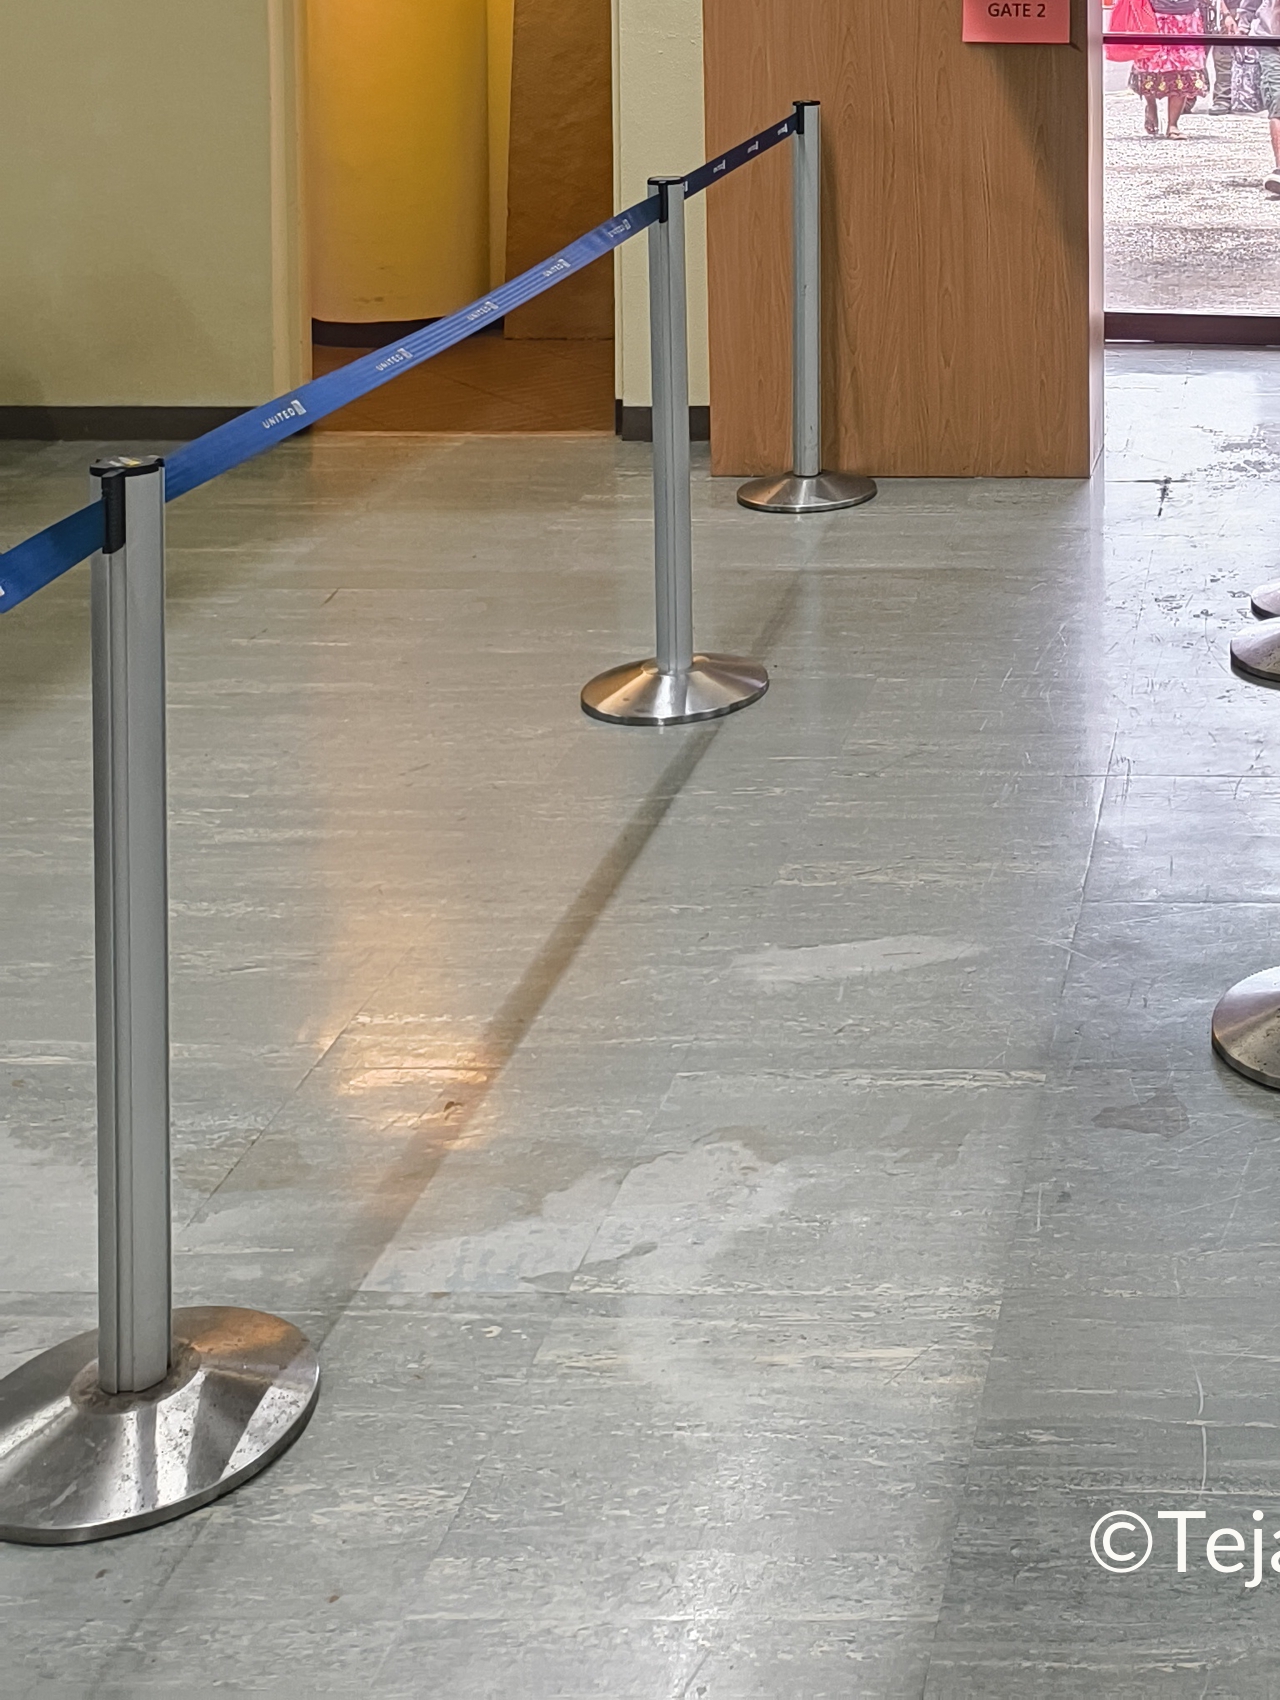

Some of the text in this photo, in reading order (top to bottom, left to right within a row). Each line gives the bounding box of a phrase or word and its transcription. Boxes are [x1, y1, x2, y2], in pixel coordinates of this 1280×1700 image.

[987, 2, 1046, 18] GATE 2
[375, 353, 404, 372] UNITED
[261, 407, 296, 429] UNITED
